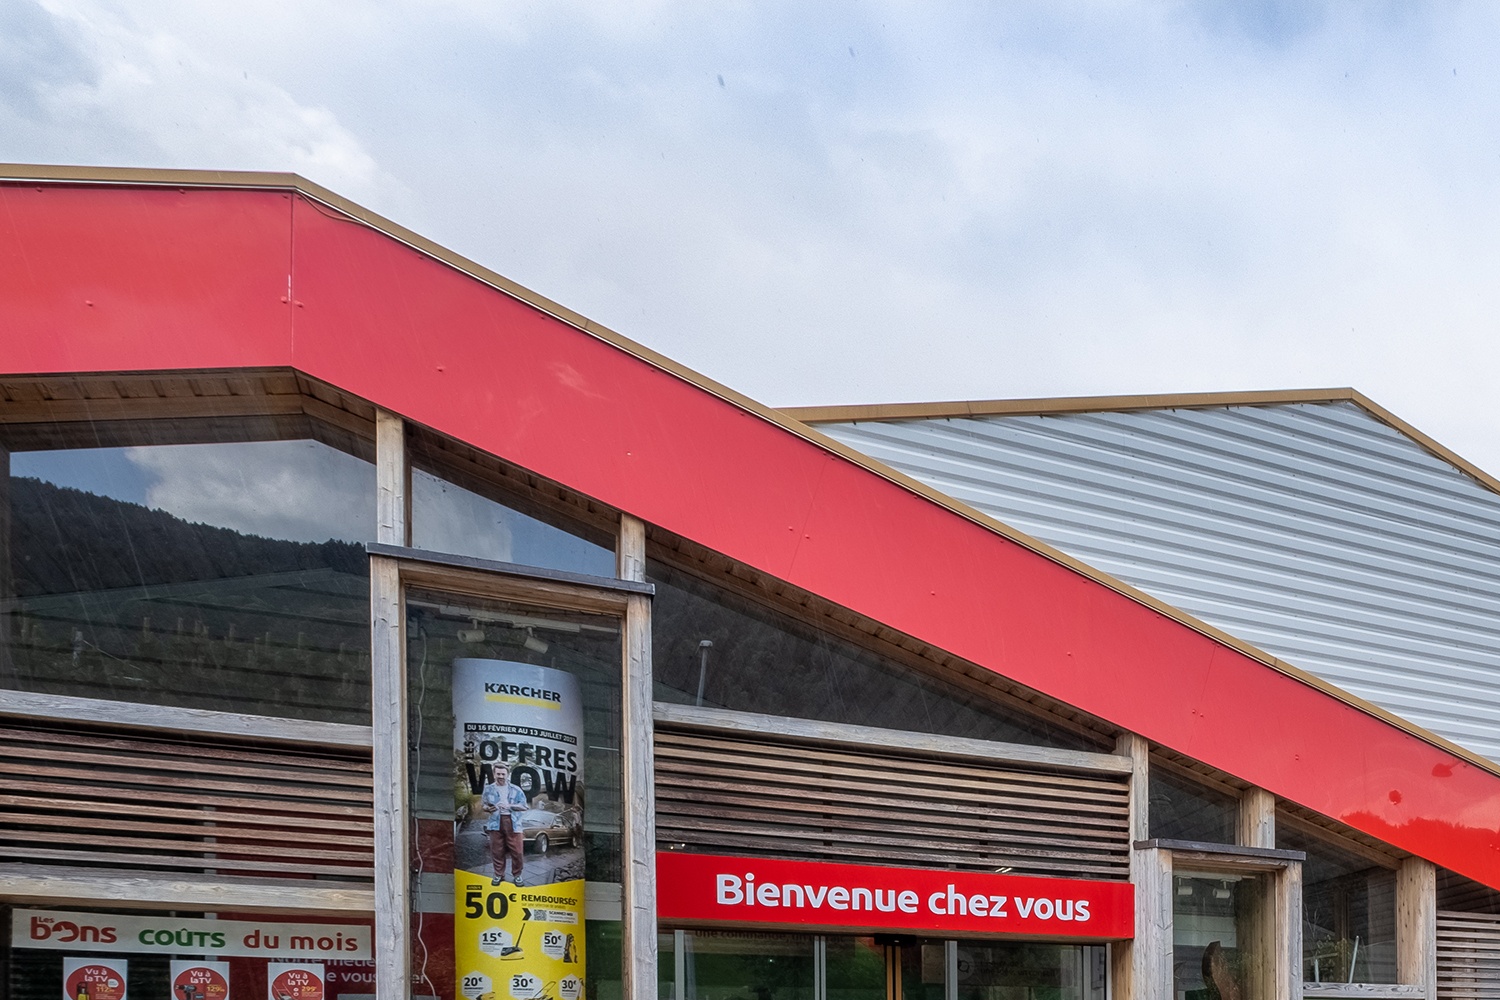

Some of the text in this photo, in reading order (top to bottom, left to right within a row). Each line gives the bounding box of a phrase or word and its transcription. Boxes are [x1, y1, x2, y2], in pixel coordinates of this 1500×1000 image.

[484, 682, 562, 703] KÄRCHER
[488, 724, 517, 733] FÉVRIER
[539, 731, 562, 740] JUILLET
[479, 740, 577, 772] OFFRES
[465, 892, 517, 919] 50€
[716, 872, 1091, 922] Bienvenue chez vous
[243, 929, 280, 949] du
[290, 932, 358, 951] mois
[464, 976, 483, 987] 20€
[512, 978, 534, 988] 30€
[561, 979, 577, 990] 30€
